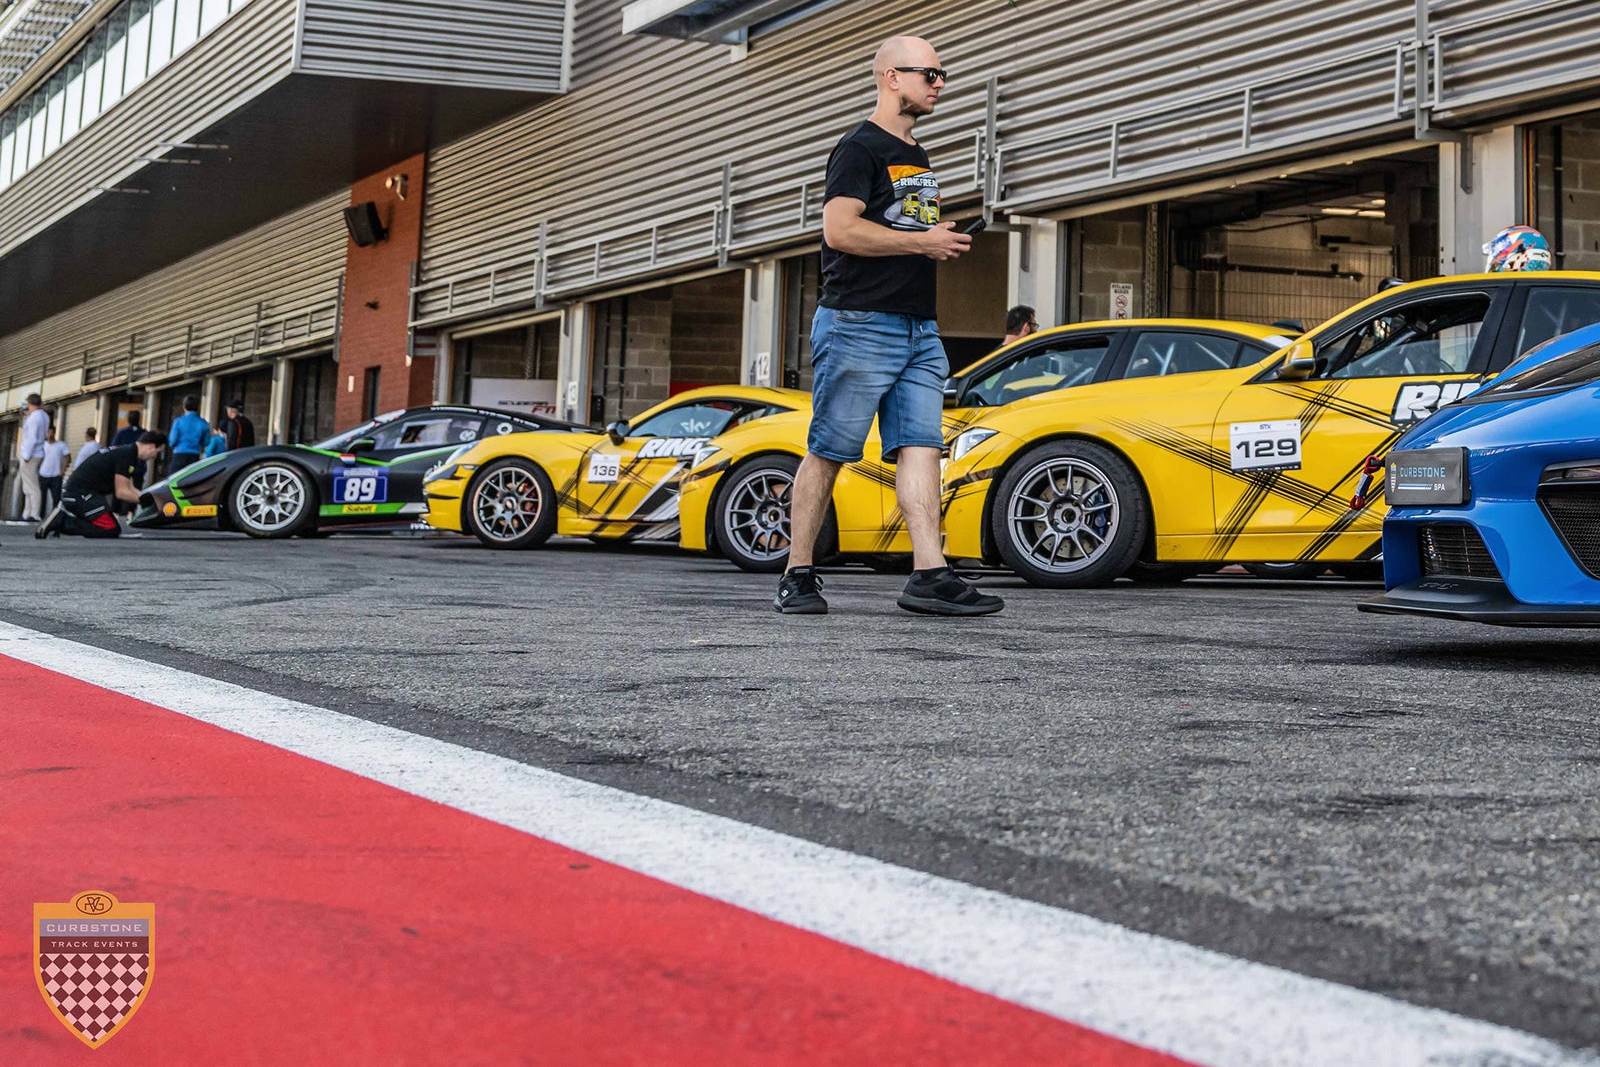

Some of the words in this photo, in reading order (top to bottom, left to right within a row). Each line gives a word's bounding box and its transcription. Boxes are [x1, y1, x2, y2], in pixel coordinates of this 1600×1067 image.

[1236, 438, 1297, 458] 129
[592, 465, 617, 476] 136
[1399, 467, 1446, 478] CURBSTONE
[344, 477, 377, 502] 89
[1434, 483, 1446, 491] SPA
